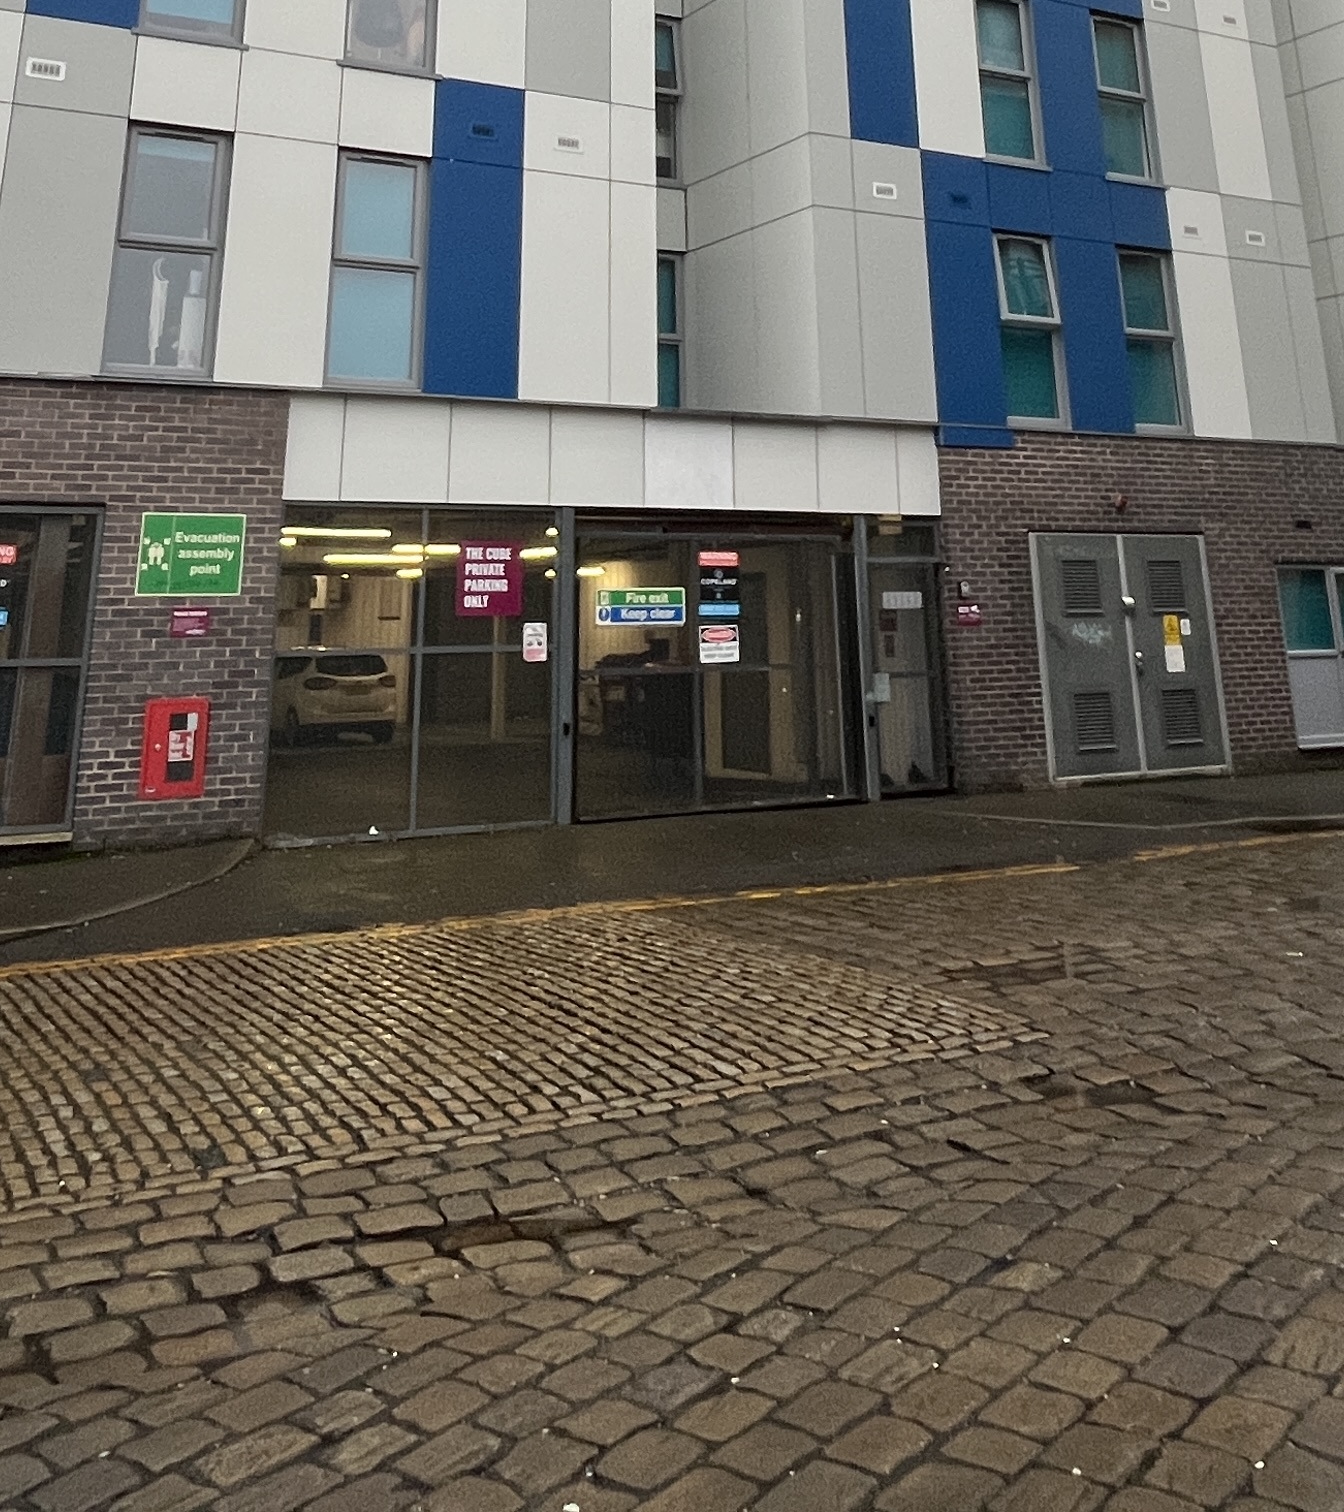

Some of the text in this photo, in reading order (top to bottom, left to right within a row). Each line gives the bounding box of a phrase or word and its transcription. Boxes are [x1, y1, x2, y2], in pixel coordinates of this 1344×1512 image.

[175, 531, 240, 543] Evacuation
[178, 548, 235, 562] assembly
[466, 547, 484, 560] THE
[189, 563, 221, 577] point
[464, 563, 506, 576] PRIVATE
[463, 578, 509, 592] PARKING
[463, 594, 489, 608] ONLY
[625, 592, 670, 604] Fire exit
[621, 607, 676, 621] Keep clear
